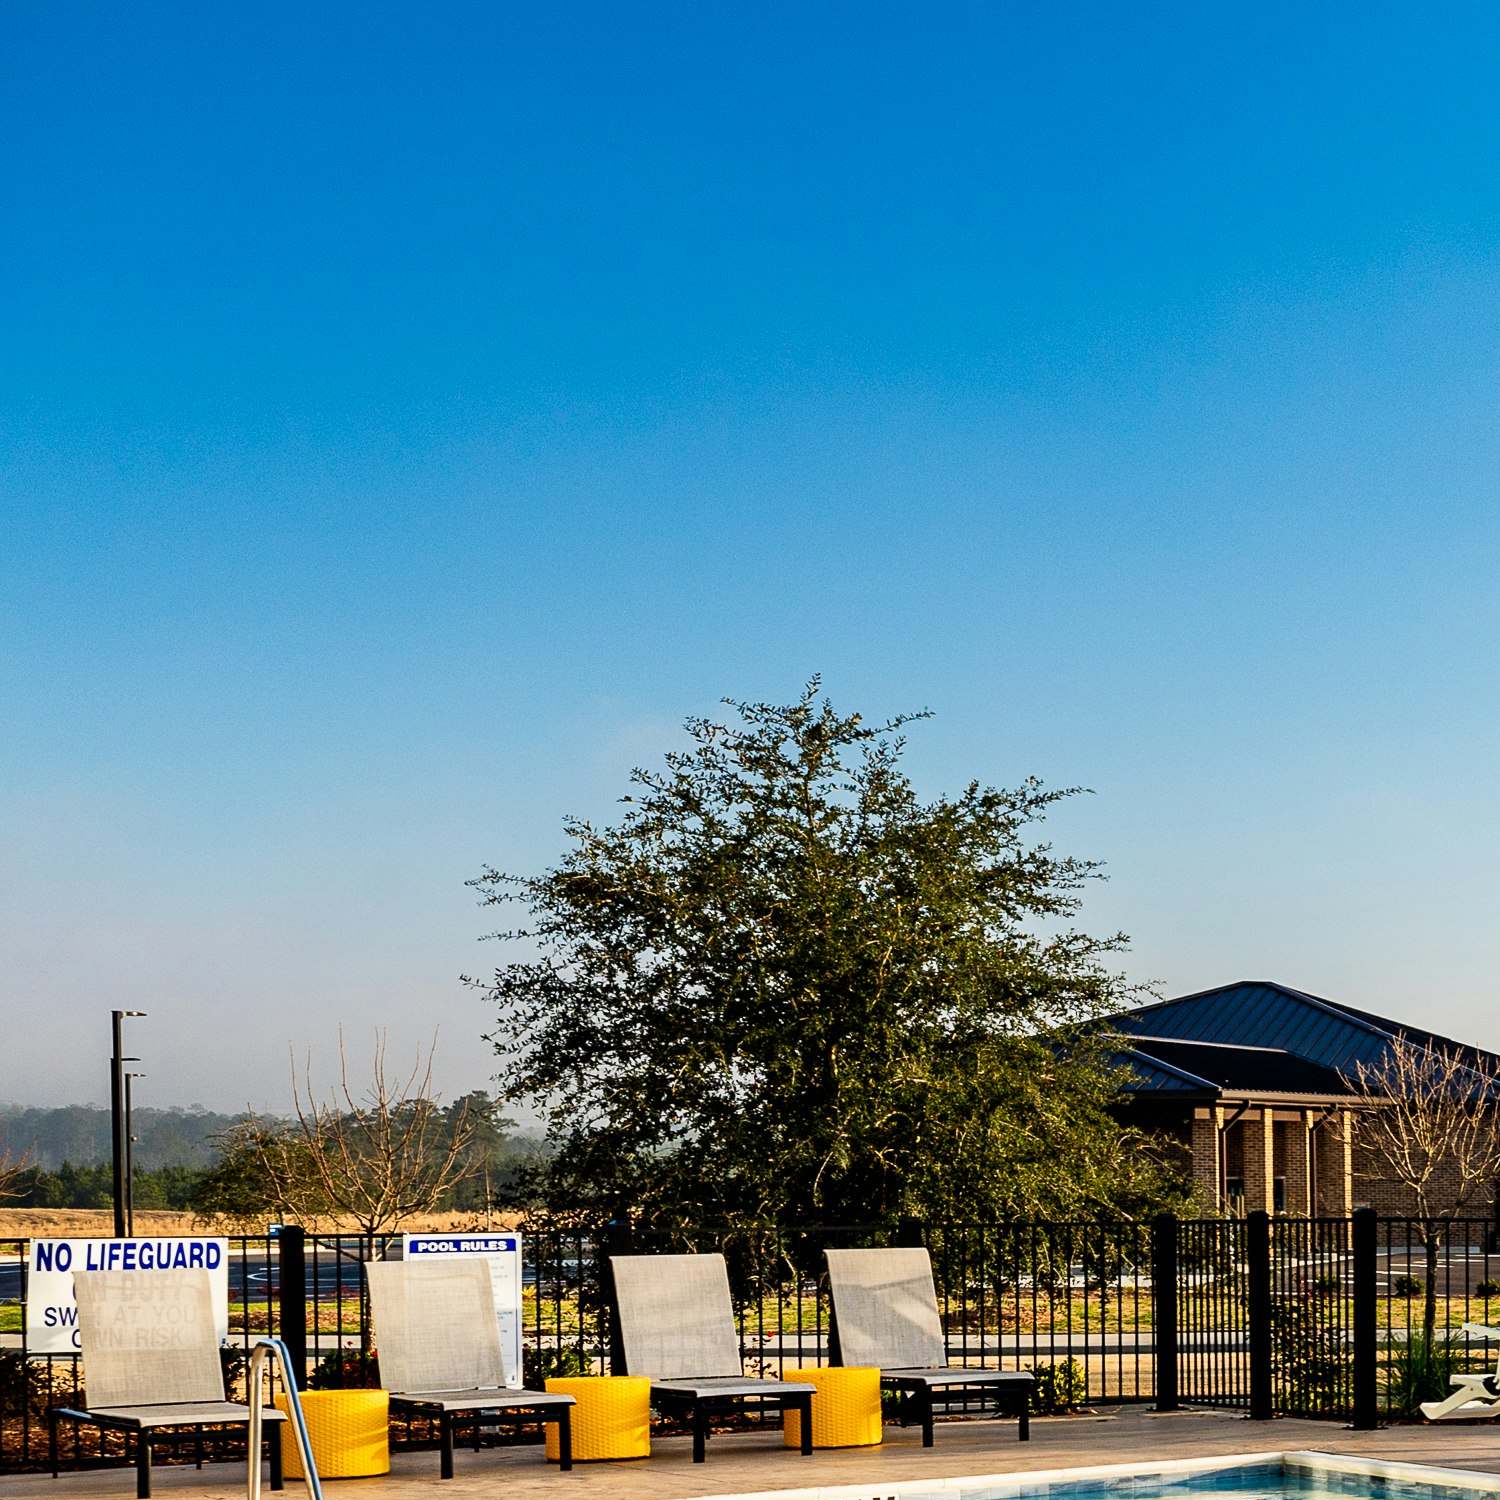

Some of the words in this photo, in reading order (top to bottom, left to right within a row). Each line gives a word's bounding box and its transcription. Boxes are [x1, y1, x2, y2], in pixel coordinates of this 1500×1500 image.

[417, 1241, 457, 1252] POOL
[460, 1240, 508, 1251] RULES
[36, 1242, 72, 1272] NO
[86, 1242, 221, 1271] LIFEGUARD
